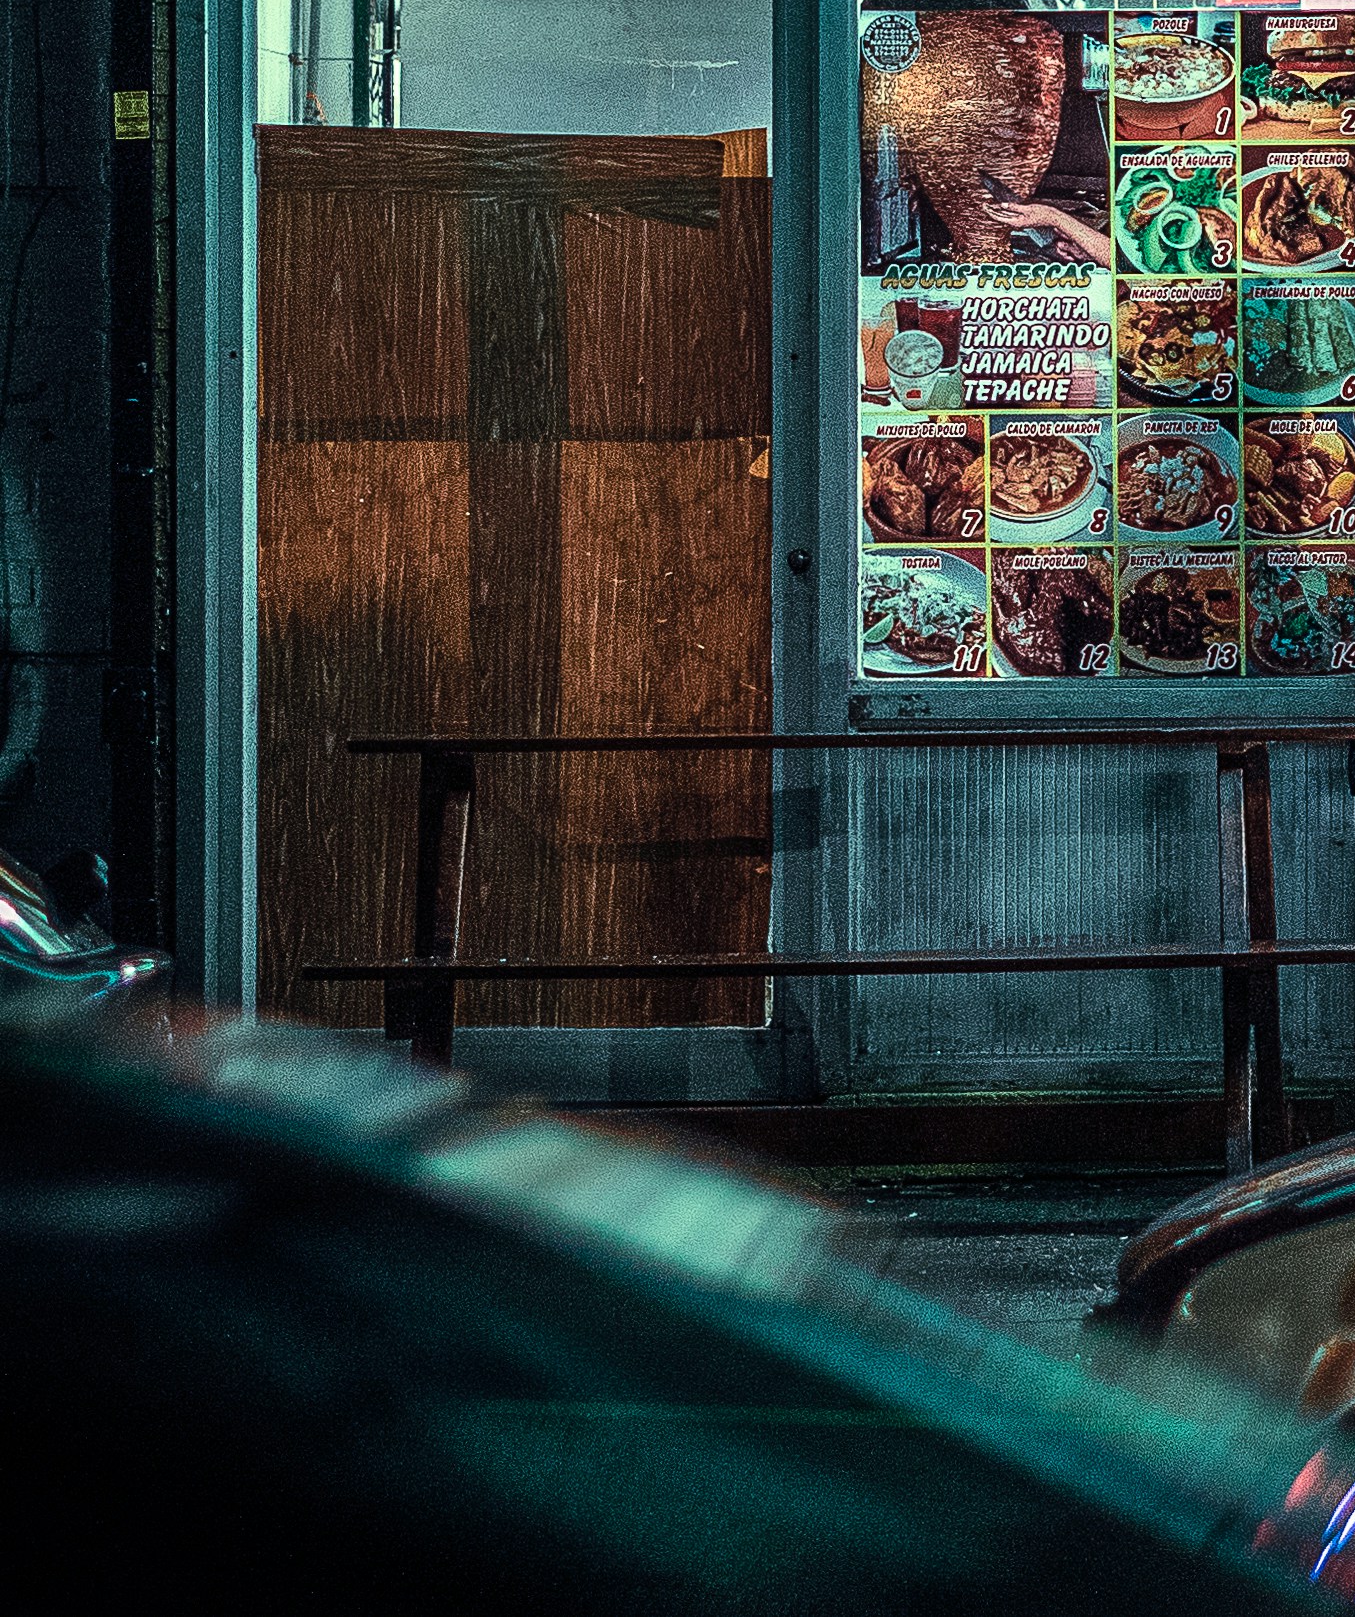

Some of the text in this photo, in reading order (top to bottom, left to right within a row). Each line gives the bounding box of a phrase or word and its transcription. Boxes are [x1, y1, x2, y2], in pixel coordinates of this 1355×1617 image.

[1152, 18, 1189, 31] POZOLE
[1266, 17, 1337, 30] HAMBURGUESA
[1215, 107, 1231, 135] 1
[1121, 155, 1233, 167] ENSALADA AGUACATE
[1268, 153, 1348, 166] CHILES RELLENOS
[1212, 239, 1232, 265] 3
[880, 262, 1095, 290] AGUAS FRESCAS
[1131, 286, 1223, 301] NACHOS QUESO
[1254, 286, 1310, 299] ENCHILADAS
[962, 297, 1089, 322] HORCHATA
[962, 324, 1109, 348] TAMARINDO
[961, 352, 1072, 375] JAMAICA
[963, 378, 1070, 402] TEPACHE
[1212, 372, 1230, 400] 5
[876, 423, 966, 438] MIXIOTES POLLO
[1006, 422, 1039, 435] CALDO
[1144, 420, 1218, 434] PANCITA RES
[1270, 420, 1336, 433] MOLE OLLA
[961, 510, 980, 538] 7
[1089, 508, 1107, 535] 8
[1215, 506, 1232, 532] 9
[901, 556, 942, 571] TOSTADA
[1014, 556, 1087, 569] MOLE POBLANO
[1268, 553, 1347, 566] TACOS PASTOR
[952, 643, 982, 672] 11
[1079, 642, 1110, 671] 12
[1206, 642, 1237, 670] 13
